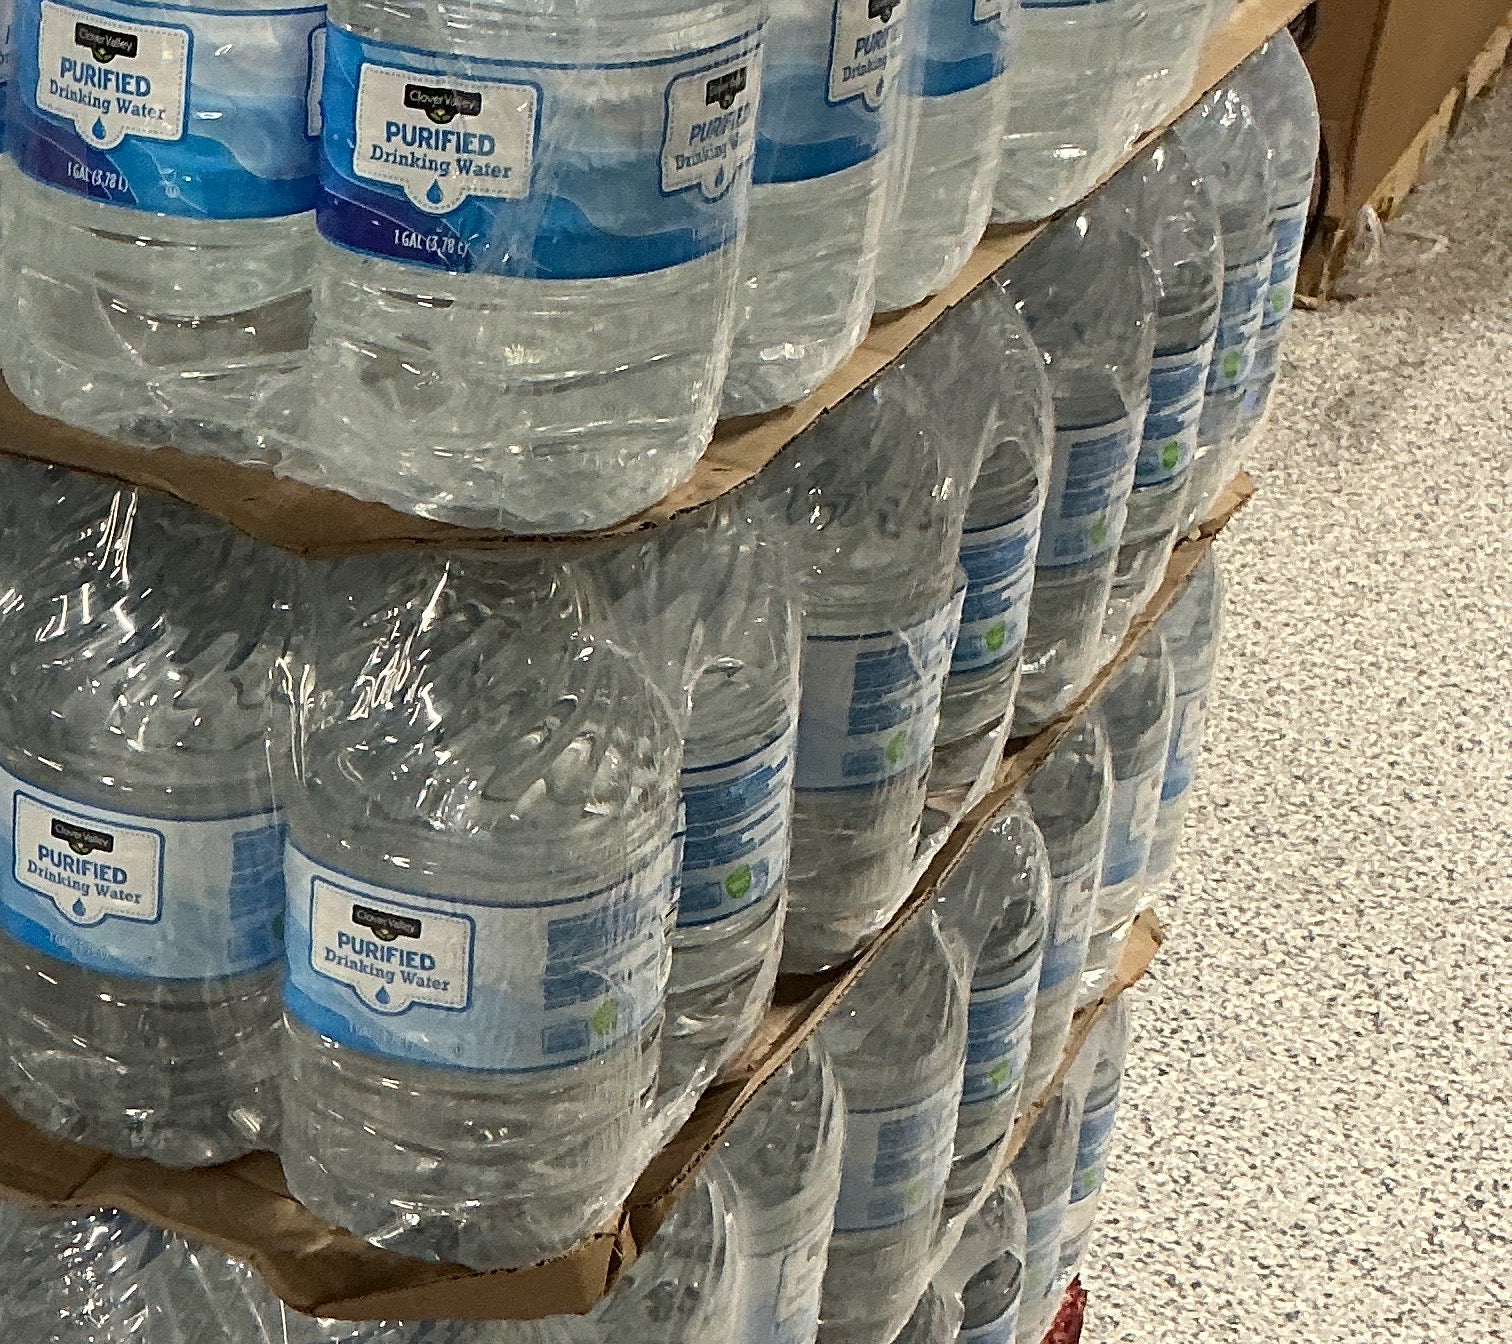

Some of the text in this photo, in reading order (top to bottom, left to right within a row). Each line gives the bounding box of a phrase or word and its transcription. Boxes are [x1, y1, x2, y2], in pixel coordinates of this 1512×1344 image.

[60, 56, 151, 97] PURIFIED
[49, 79, 166, 121] Drinking Water
[409, 89, 445, 106] Clover
[386, 120, 495, 157] PURIFIED
[370, 144, 513, 180] Drinking Water
[401, 230, 423, 249] GAL
[27, 859, 143, 905] Drinking Water
[38, 843, 128, 886] PURIFIED
[324, 947, 451, 993] Drinking Water
[338, 930, 436, 972] PURIFIED
